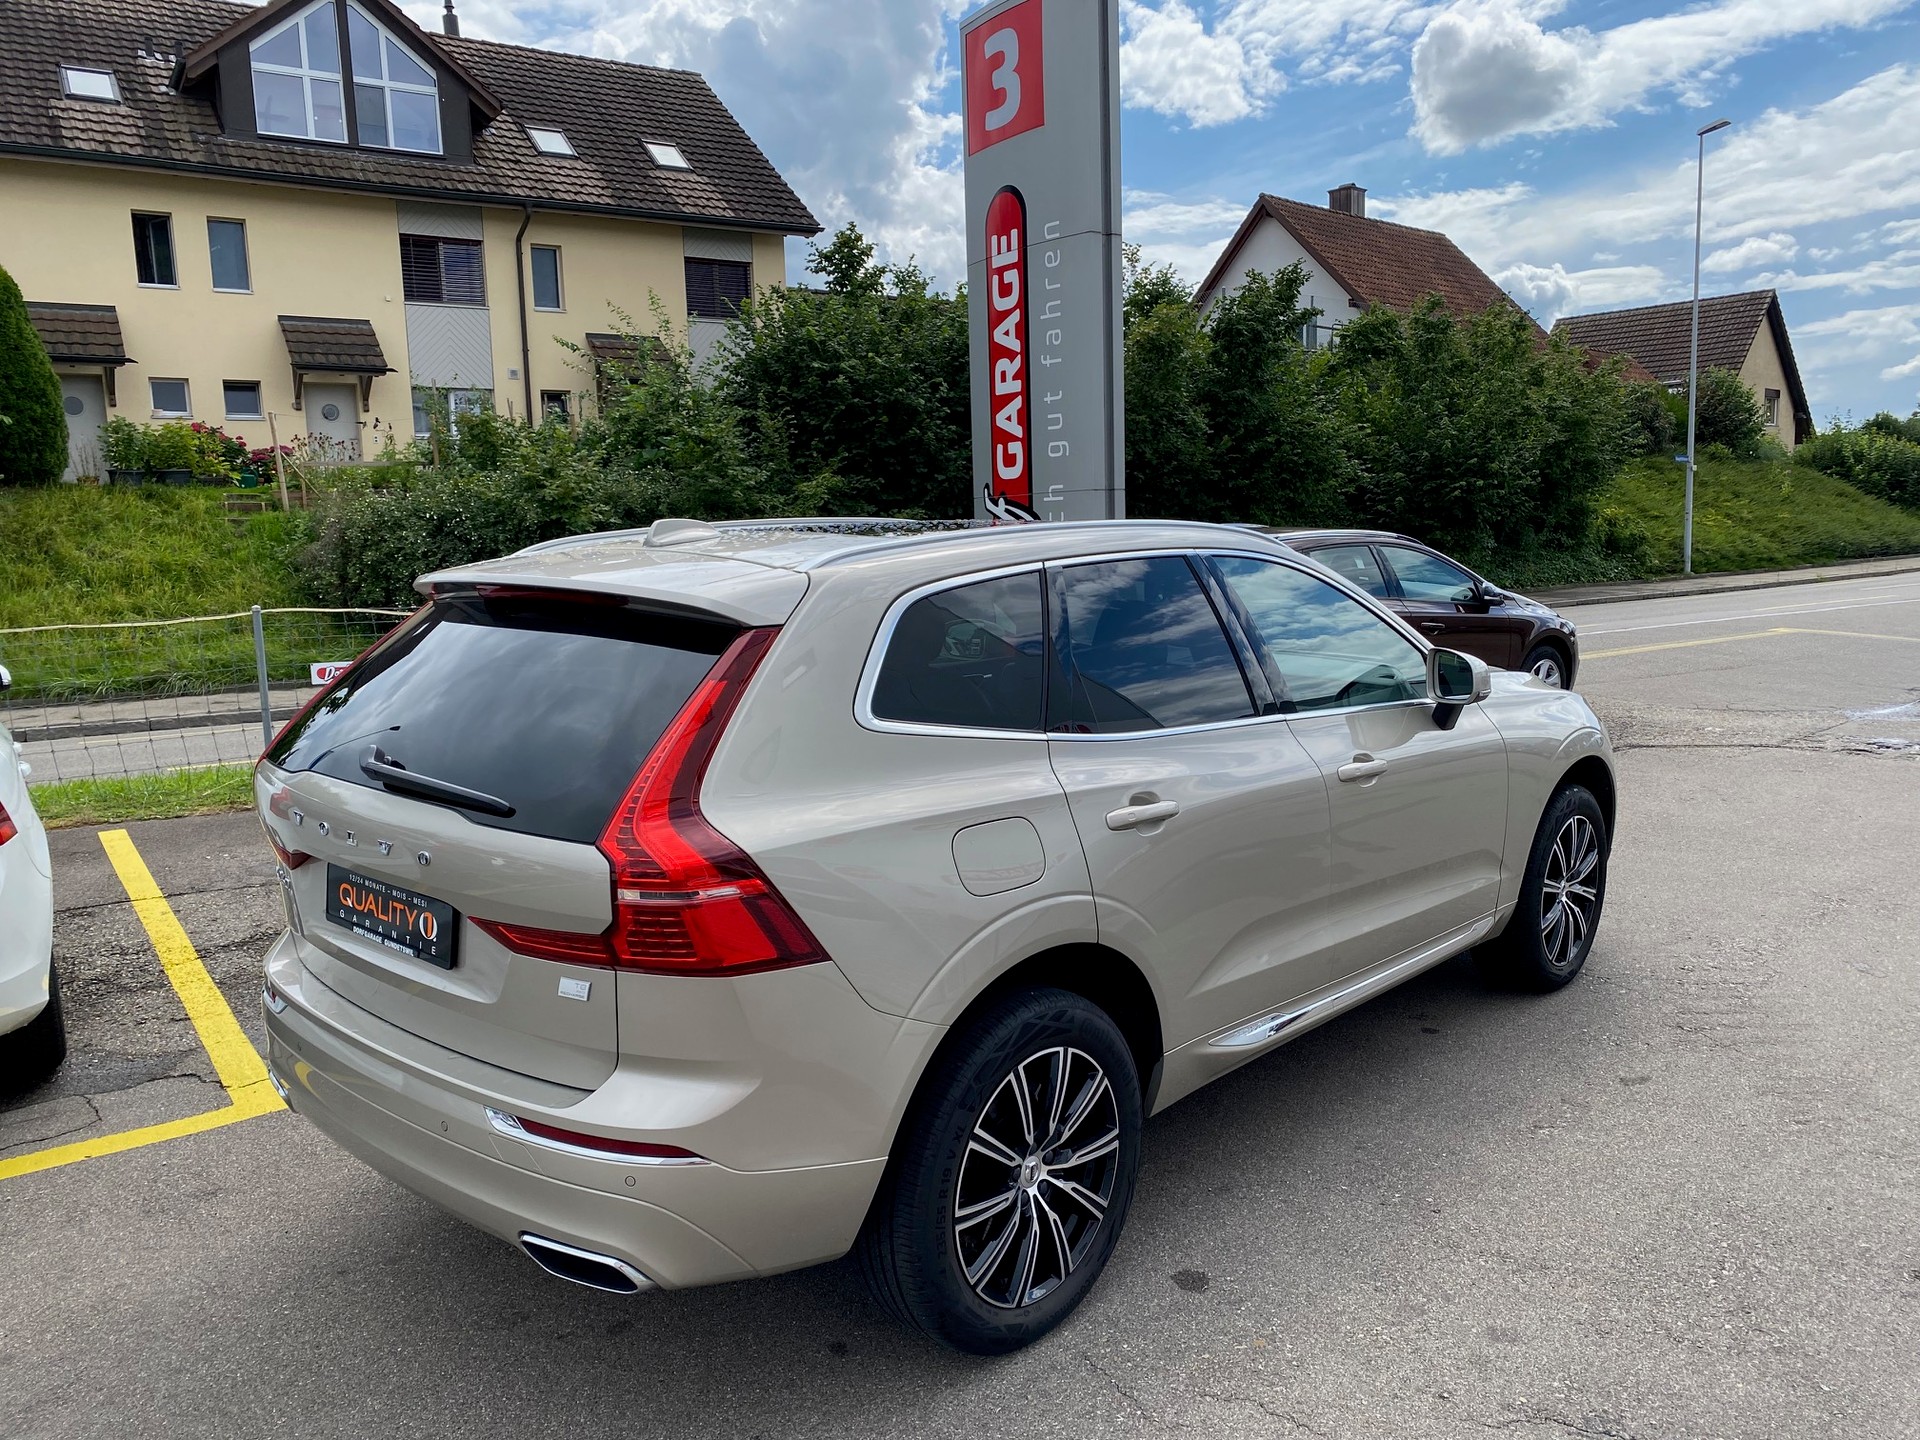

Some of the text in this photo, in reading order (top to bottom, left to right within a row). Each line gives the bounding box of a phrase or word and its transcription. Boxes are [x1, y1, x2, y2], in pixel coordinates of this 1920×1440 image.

[983, 27, 1022, 132] 3
[1040, 219, 1064, 368] fahren
[990, 227, 1025, 481] GARAGE
[1044, 389, 1069, 458] gut
[293, 809, 432, 867] VOLVO
[338, 882, 418, 931] QUALITY
[349, 874, 364, 885] 12/24
[364, 878, 386, 893] MONATE
[392, 889, 407, 900] MOIS
[412, 896, 428, 908] MESI
[339, 909, 437, 956] GARANTIE
